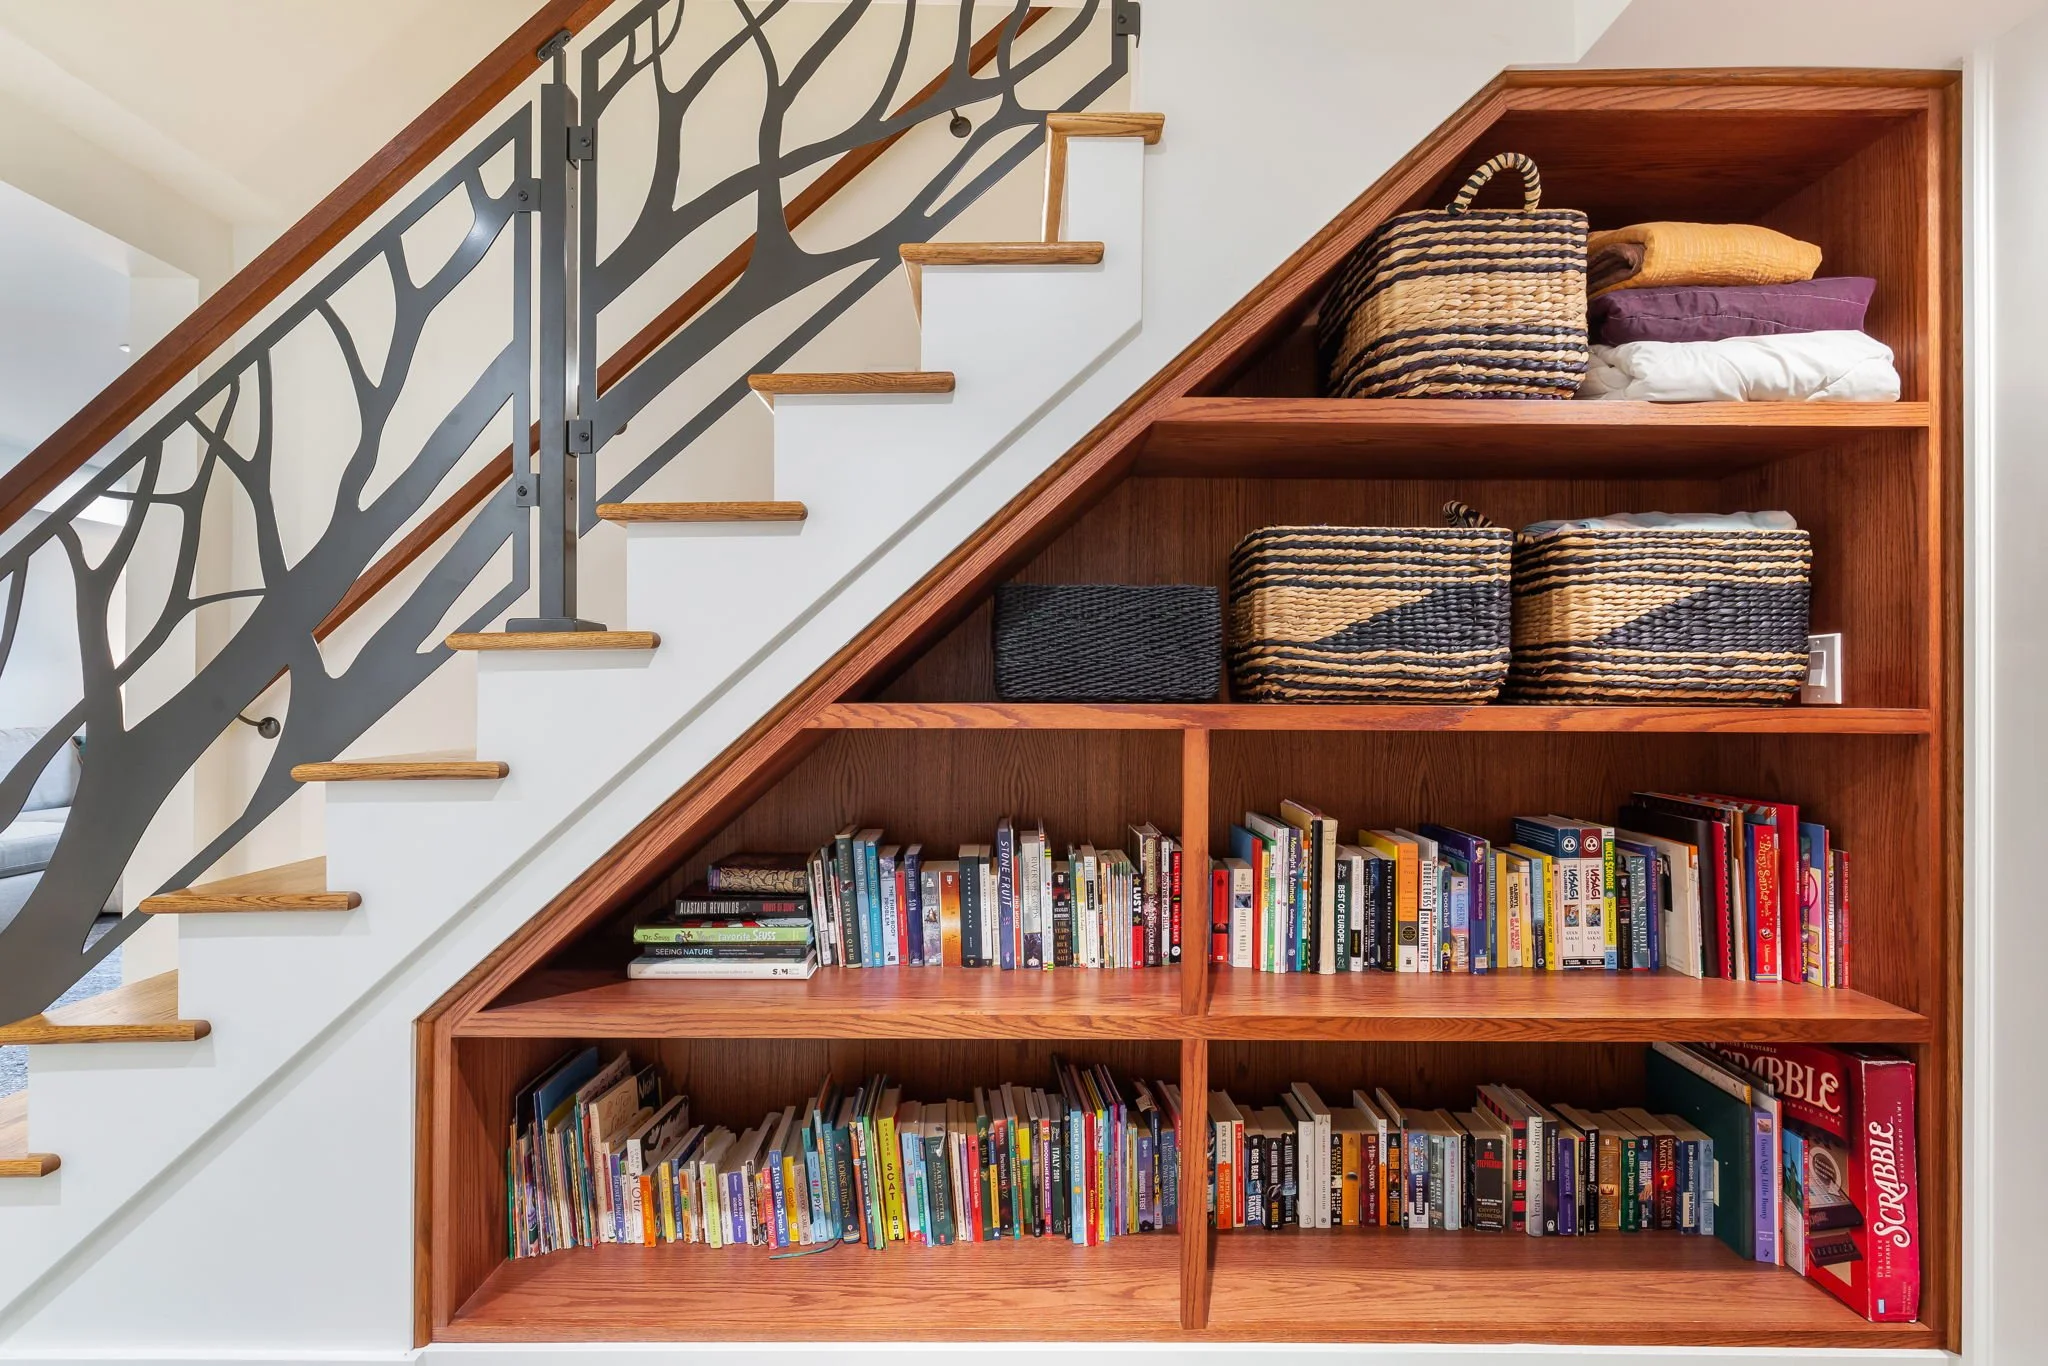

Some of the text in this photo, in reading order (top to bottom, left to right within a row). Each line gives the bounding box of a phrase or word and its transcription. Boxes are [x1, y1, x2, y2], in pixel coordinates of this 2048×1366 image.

[1030, 856, 1038, 879] RIVER
[1289, 836, 1297, 868] Moonlight
[1605, 841, 1615, 889] UNCLE SCROOGE
[856, 848, 866, 895] RINGING TRUE
[999, 840, 1012, 908] STONE FRUIT
[1570, 868, 1579, 900] USAGI
[1591, 868, 1601, 900] USAGI
[1637, 859, 1646, 903] SALMAN
[1758, 870, 1772, 901] Santa
[679, 901, 740, 914] ALASTAIR REYNOLDS
[1133, 886, 1141, 914] LUST
[1337, 884, 1345, 903] BEST
[1337, 903, 1345, 914] OF
[1420, 912, 1429, 925] BEN
[1442, 892, 1450, 928] poached
[1336, 914, 1345, 943] EUROPE
[655, 948, 682, 956] SEEING
[683, 948, 713, 956] NATURE
[1052, 1147, 1060, 1168] ITALY
[1250, 1148, 1259, 1181] GREG BEAR
[1659, 1139, 1667, 1172] MARTIN
[772, 1166, 785, 1235] Little Blue Truck
[1869, 1121, 1911, 1248] SCRABBLE
[1247, 1195, 1256, 1221] RADIO
